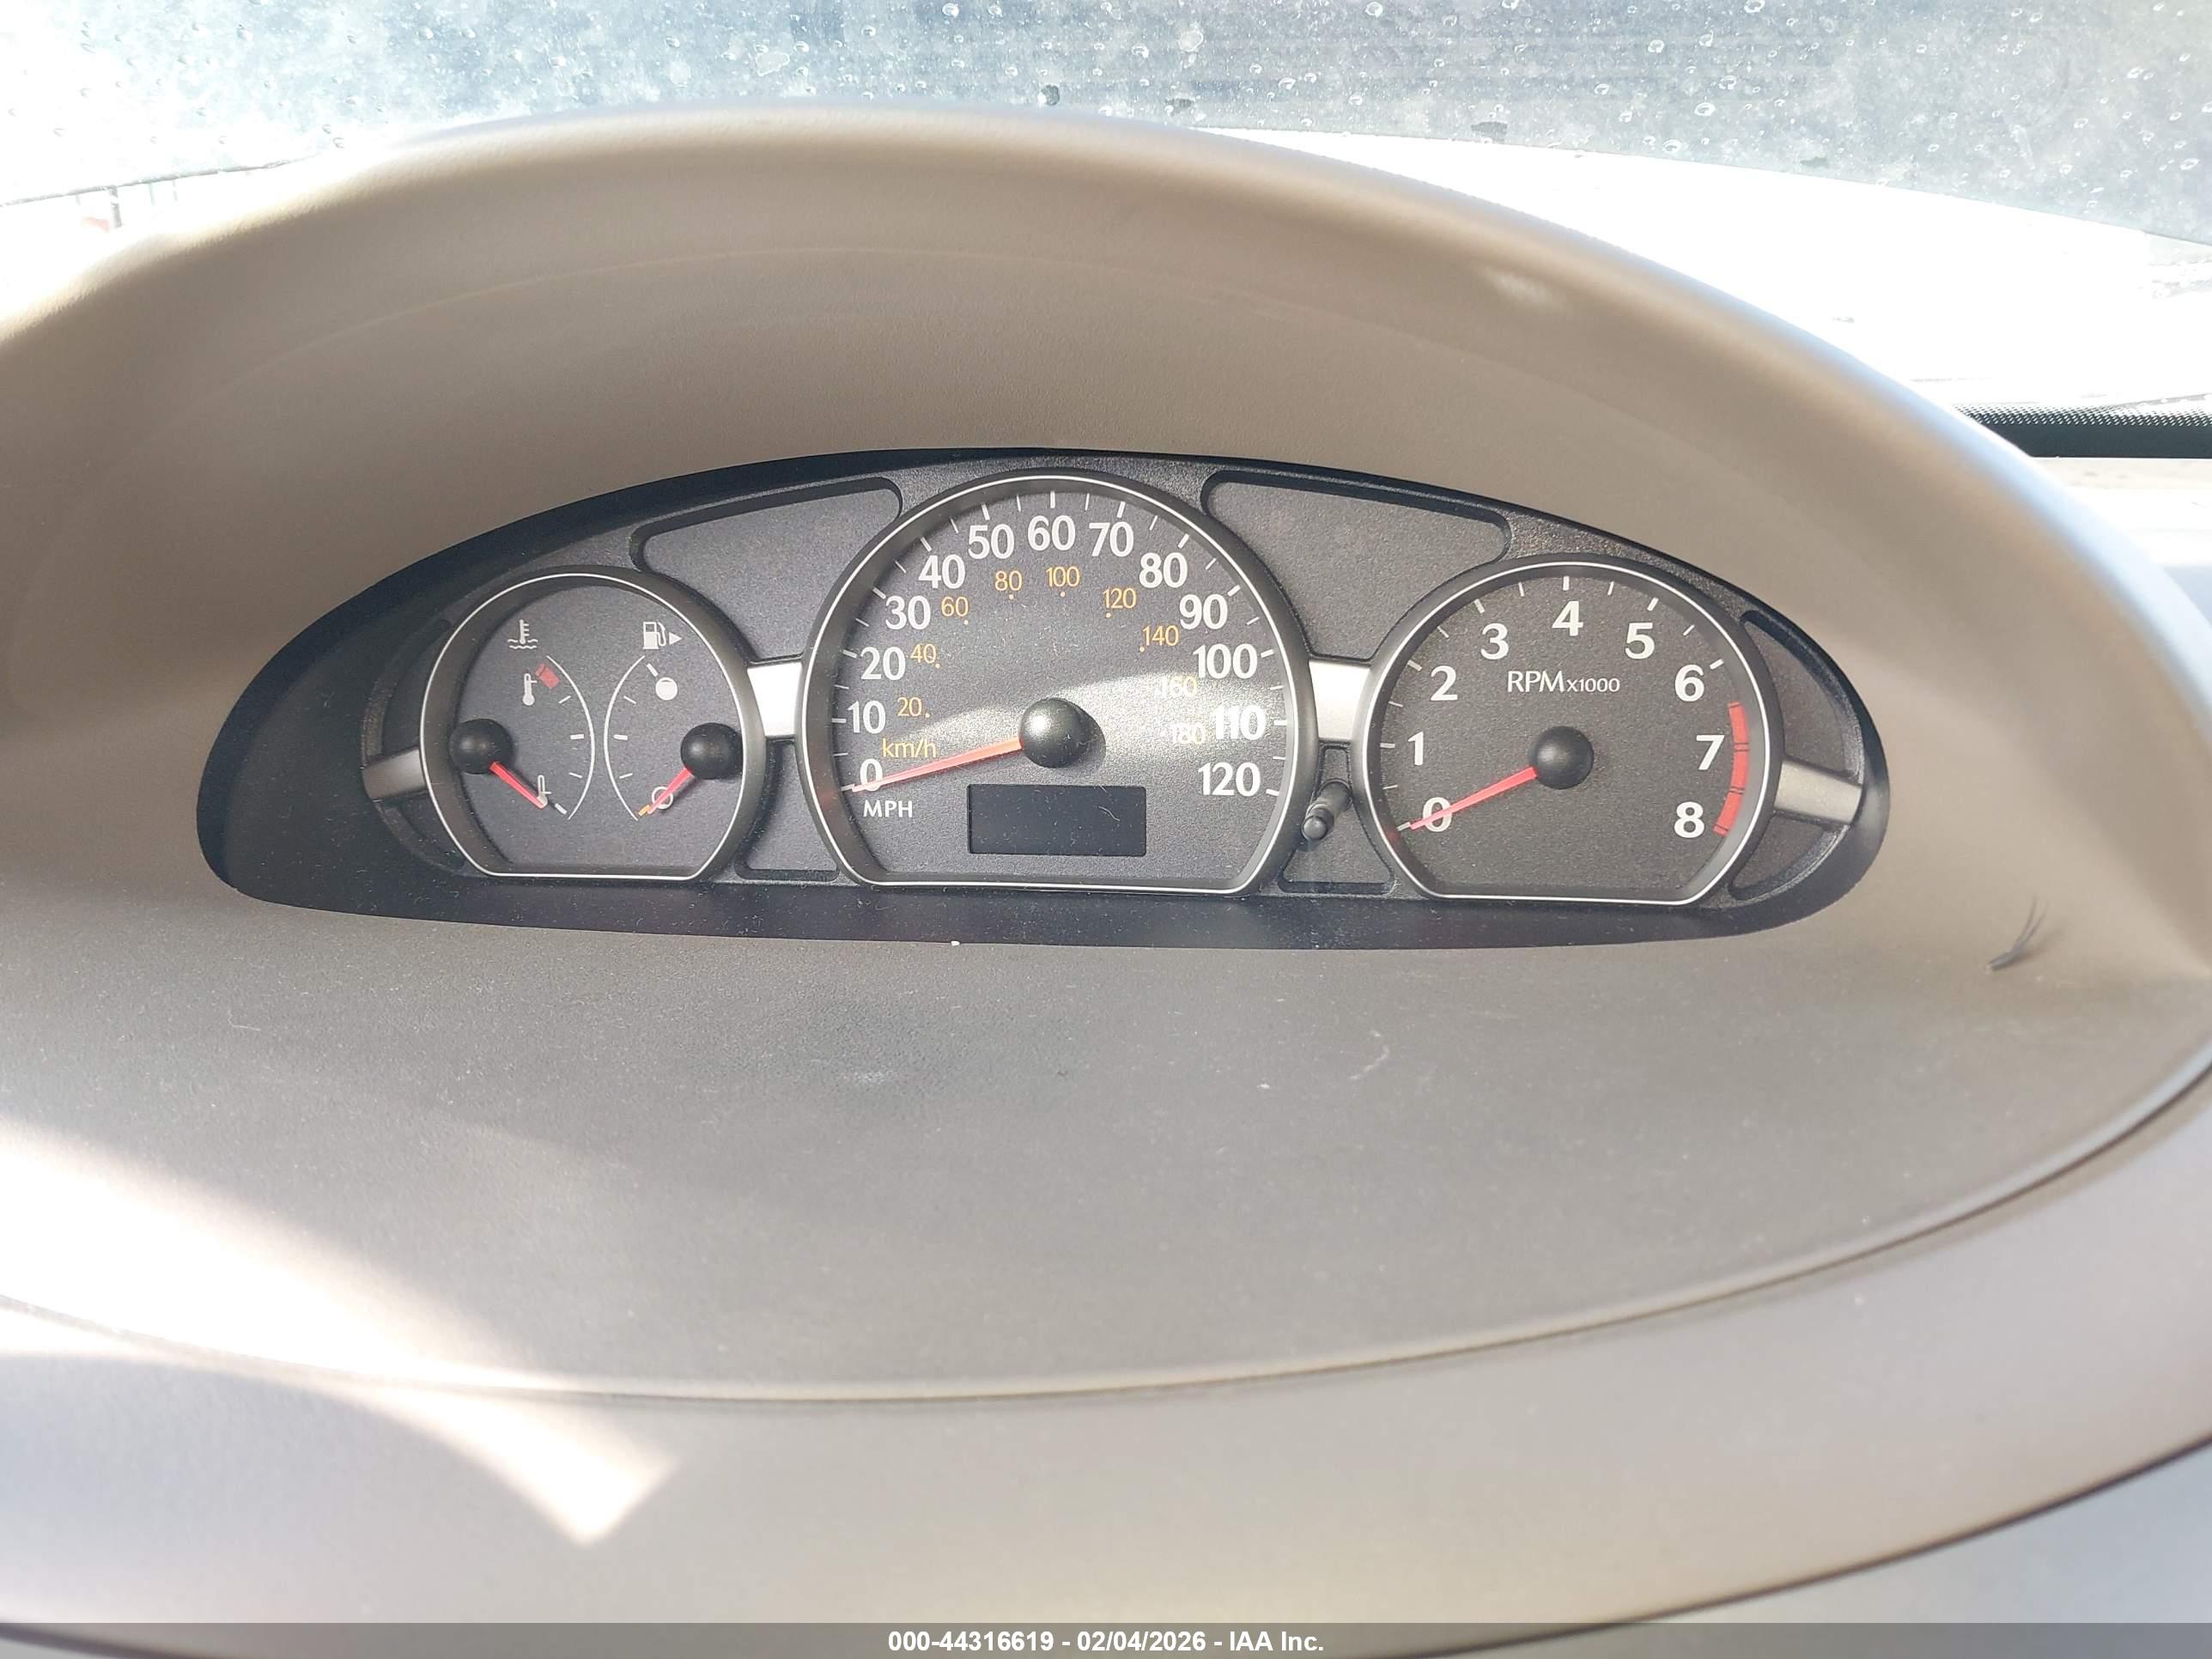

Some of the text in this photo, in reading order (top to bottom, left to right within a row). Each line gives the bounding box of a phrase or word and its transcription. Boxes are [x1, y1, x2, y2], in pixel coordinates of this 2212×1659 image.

[968, 524, 1014, 559] 50
[1027, 515, 1075, 550] 60
[1089, 521, 1134, 557] 70
[918, 555, 965, 589] 40
[994, 570, 1023, 591] 80
[1046, 566, 1080, 587] 100
[1139, 552, 1188, 588] 80
[885, 596, 930, 629] 30
[941, 597, 969, 617] 60
[1103, 587, 1137, 609] 120
[1179, 593, 1228, 629] 90
[1142, 625, 1179, 647] 140
[1553, 601, 1583, 636] 4
[910, 644, 937, 663] 40
[1481, 623, 1509, 659] 3
[1625, 623, 1655, 659] 5
[860, 647, 906, 680] 20
[1193, 643, 1257, 678] 100
[1431, 665, 1458, 701] 2
[1674, 665, 1705, 702] 6
[848, 700, 886, 733] 10
[897, 697, 922, 717] 20
[1212, 704, 1266, 740] 110
[882, 738, 937, 757] km/h
[1408, 732, 1424, 765] 1
[1696, 735, 1725, 770] 7
[860, 759, 883, 792] 0
[1198, 762, 1261, 797] 120
[863, 800, 913, 817] MPH
[1422, 797, 1452, 832] 0
[1674, 802, 1705, 838] 8
